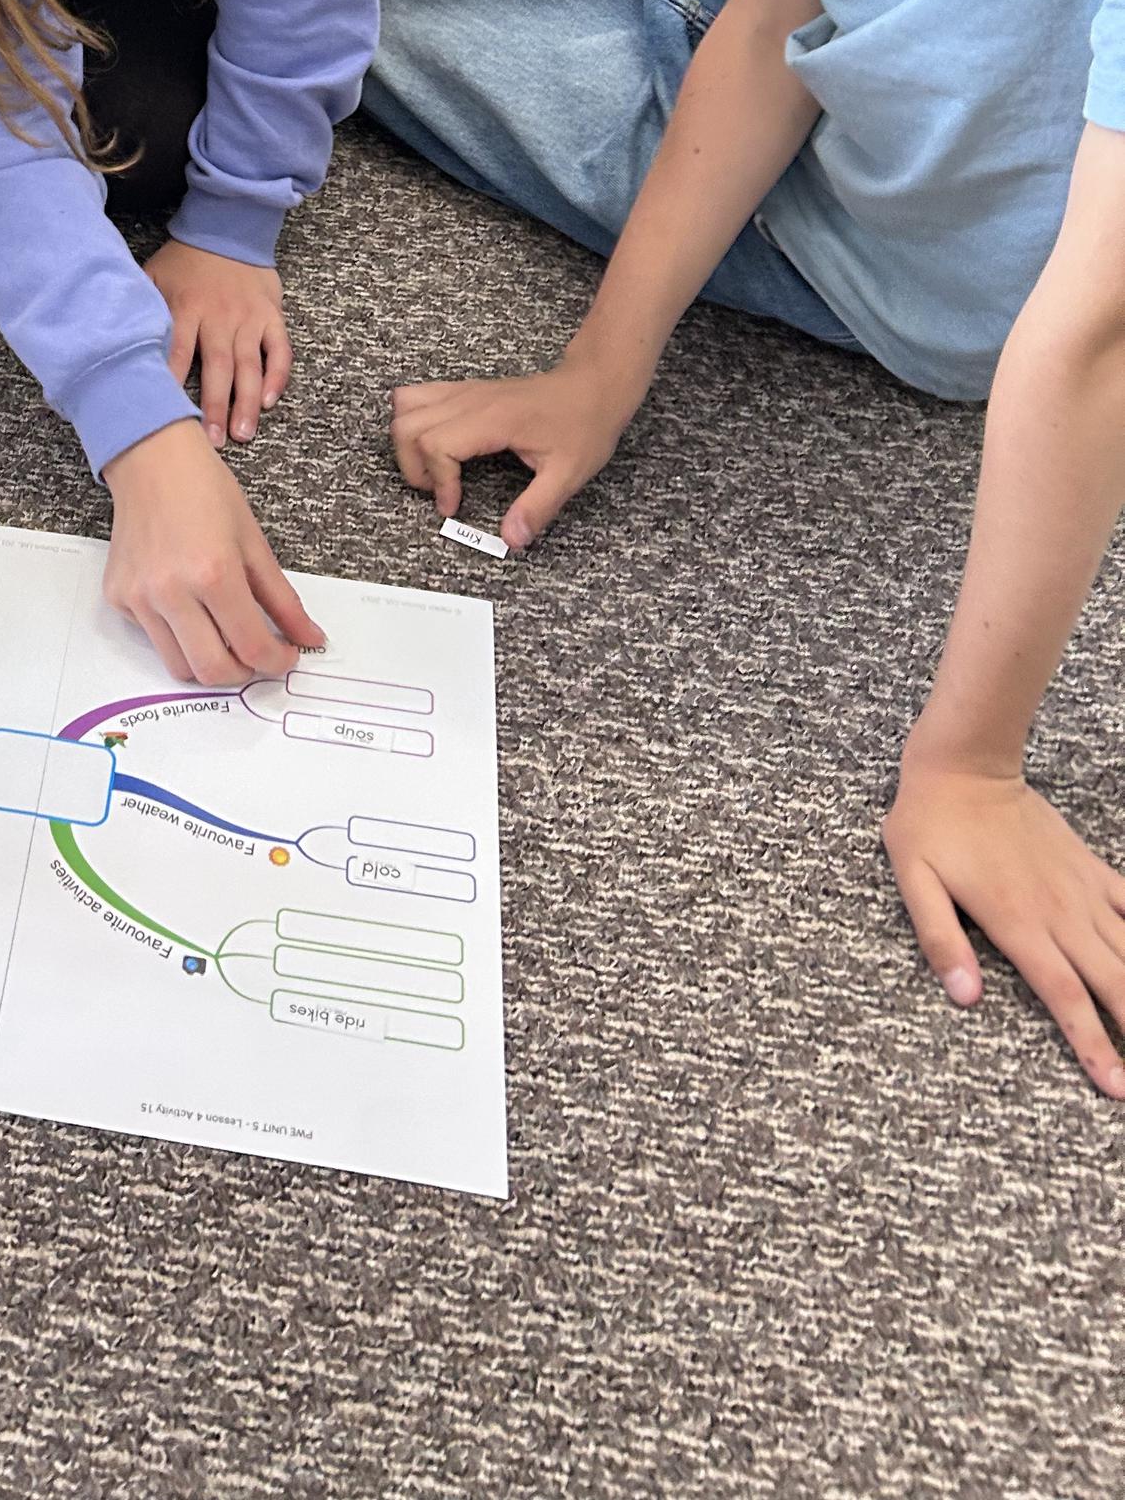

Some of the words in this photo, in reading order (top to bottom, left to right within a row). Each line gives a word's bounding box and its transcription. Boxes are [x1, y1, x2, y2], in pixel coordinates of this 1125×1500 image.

[456, 526, 483, 546] Kim
[119, 707, 161, 729] foods
[161, 700, 231, 720] Favourite
[334, 722, 375, 743] soup
[120, 796, 180, 827] weather
[183, 819, 256, 857] Favourite
[361, 859, 402, 881] cold
[49, 858, 104, 914] activities
[103, 909, 174, 961] Favourite
[288, 1003, 331, 1026] bikes
[334, 1011, 366, 1030] ride
[140, 1102, 152, 1114] 15
[156, 1104, 193, 1119] Activity
[197, 1112, 203, 1121] 4
[205, 1113, 242, 1128] Lesson
[253, 1121, 259, 1131] 5
[262, 1123, 287, 1135] UNIT
[290, 1127, 313, 1140] PWE
